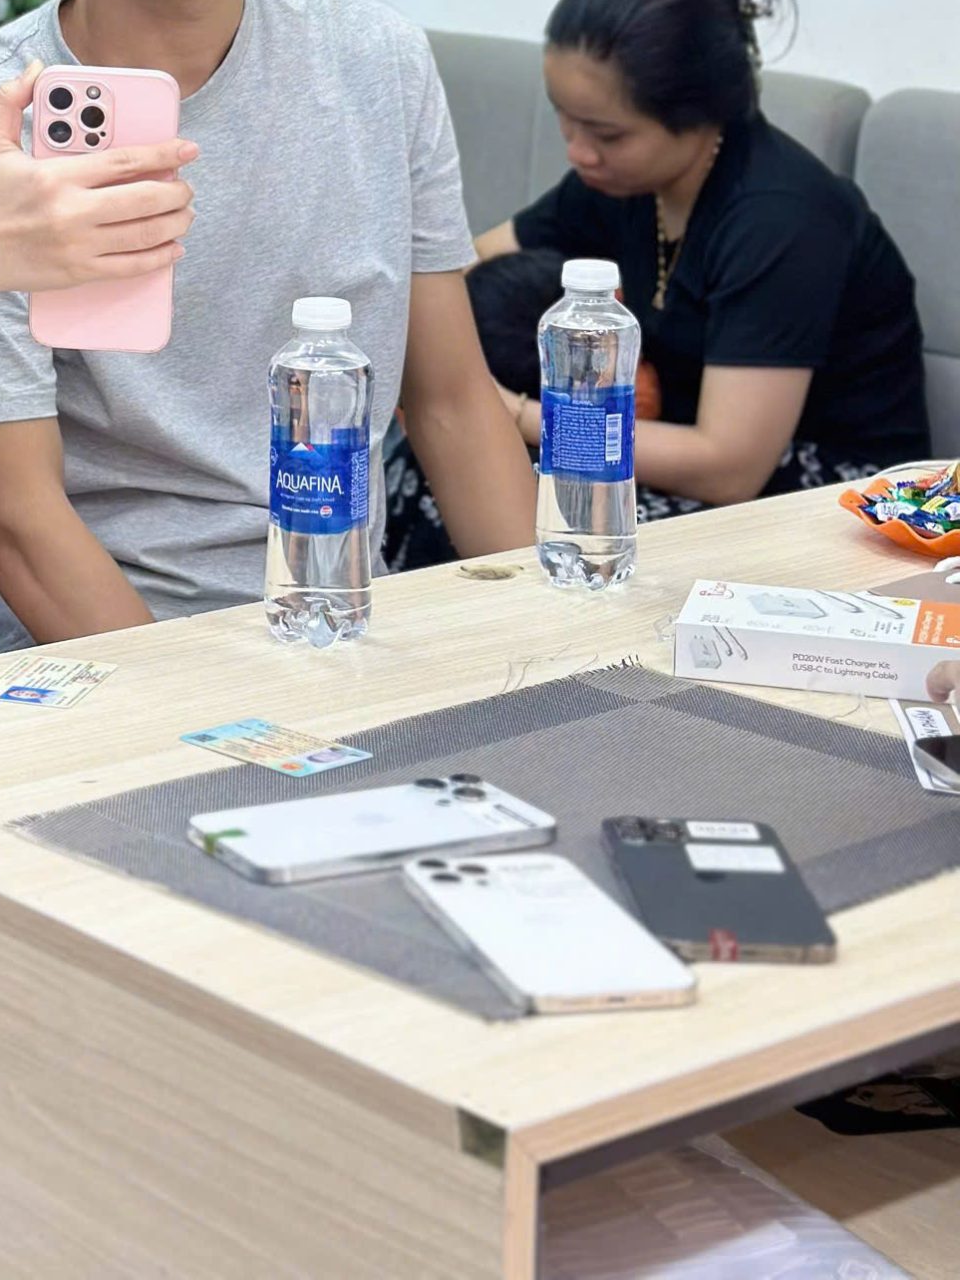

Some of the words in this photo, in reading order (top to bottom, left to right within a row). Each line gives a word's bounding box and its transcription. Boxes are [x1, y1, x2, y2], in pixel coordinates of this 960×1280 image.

[276, 469, 342, 495] AQUAFINA
[792, 653, 825, 663] PD20W
[825, 656, 844, 665] Fast
[844, 658, 877, 669] Charger
[878, 661, 891, 670] Kit
[792, 663, 823, 673] (USB-C
[824, 666, 833, 674] to
[834, 667, 871, 679] Lightning
[872, 671, 898, 681] Cable)
